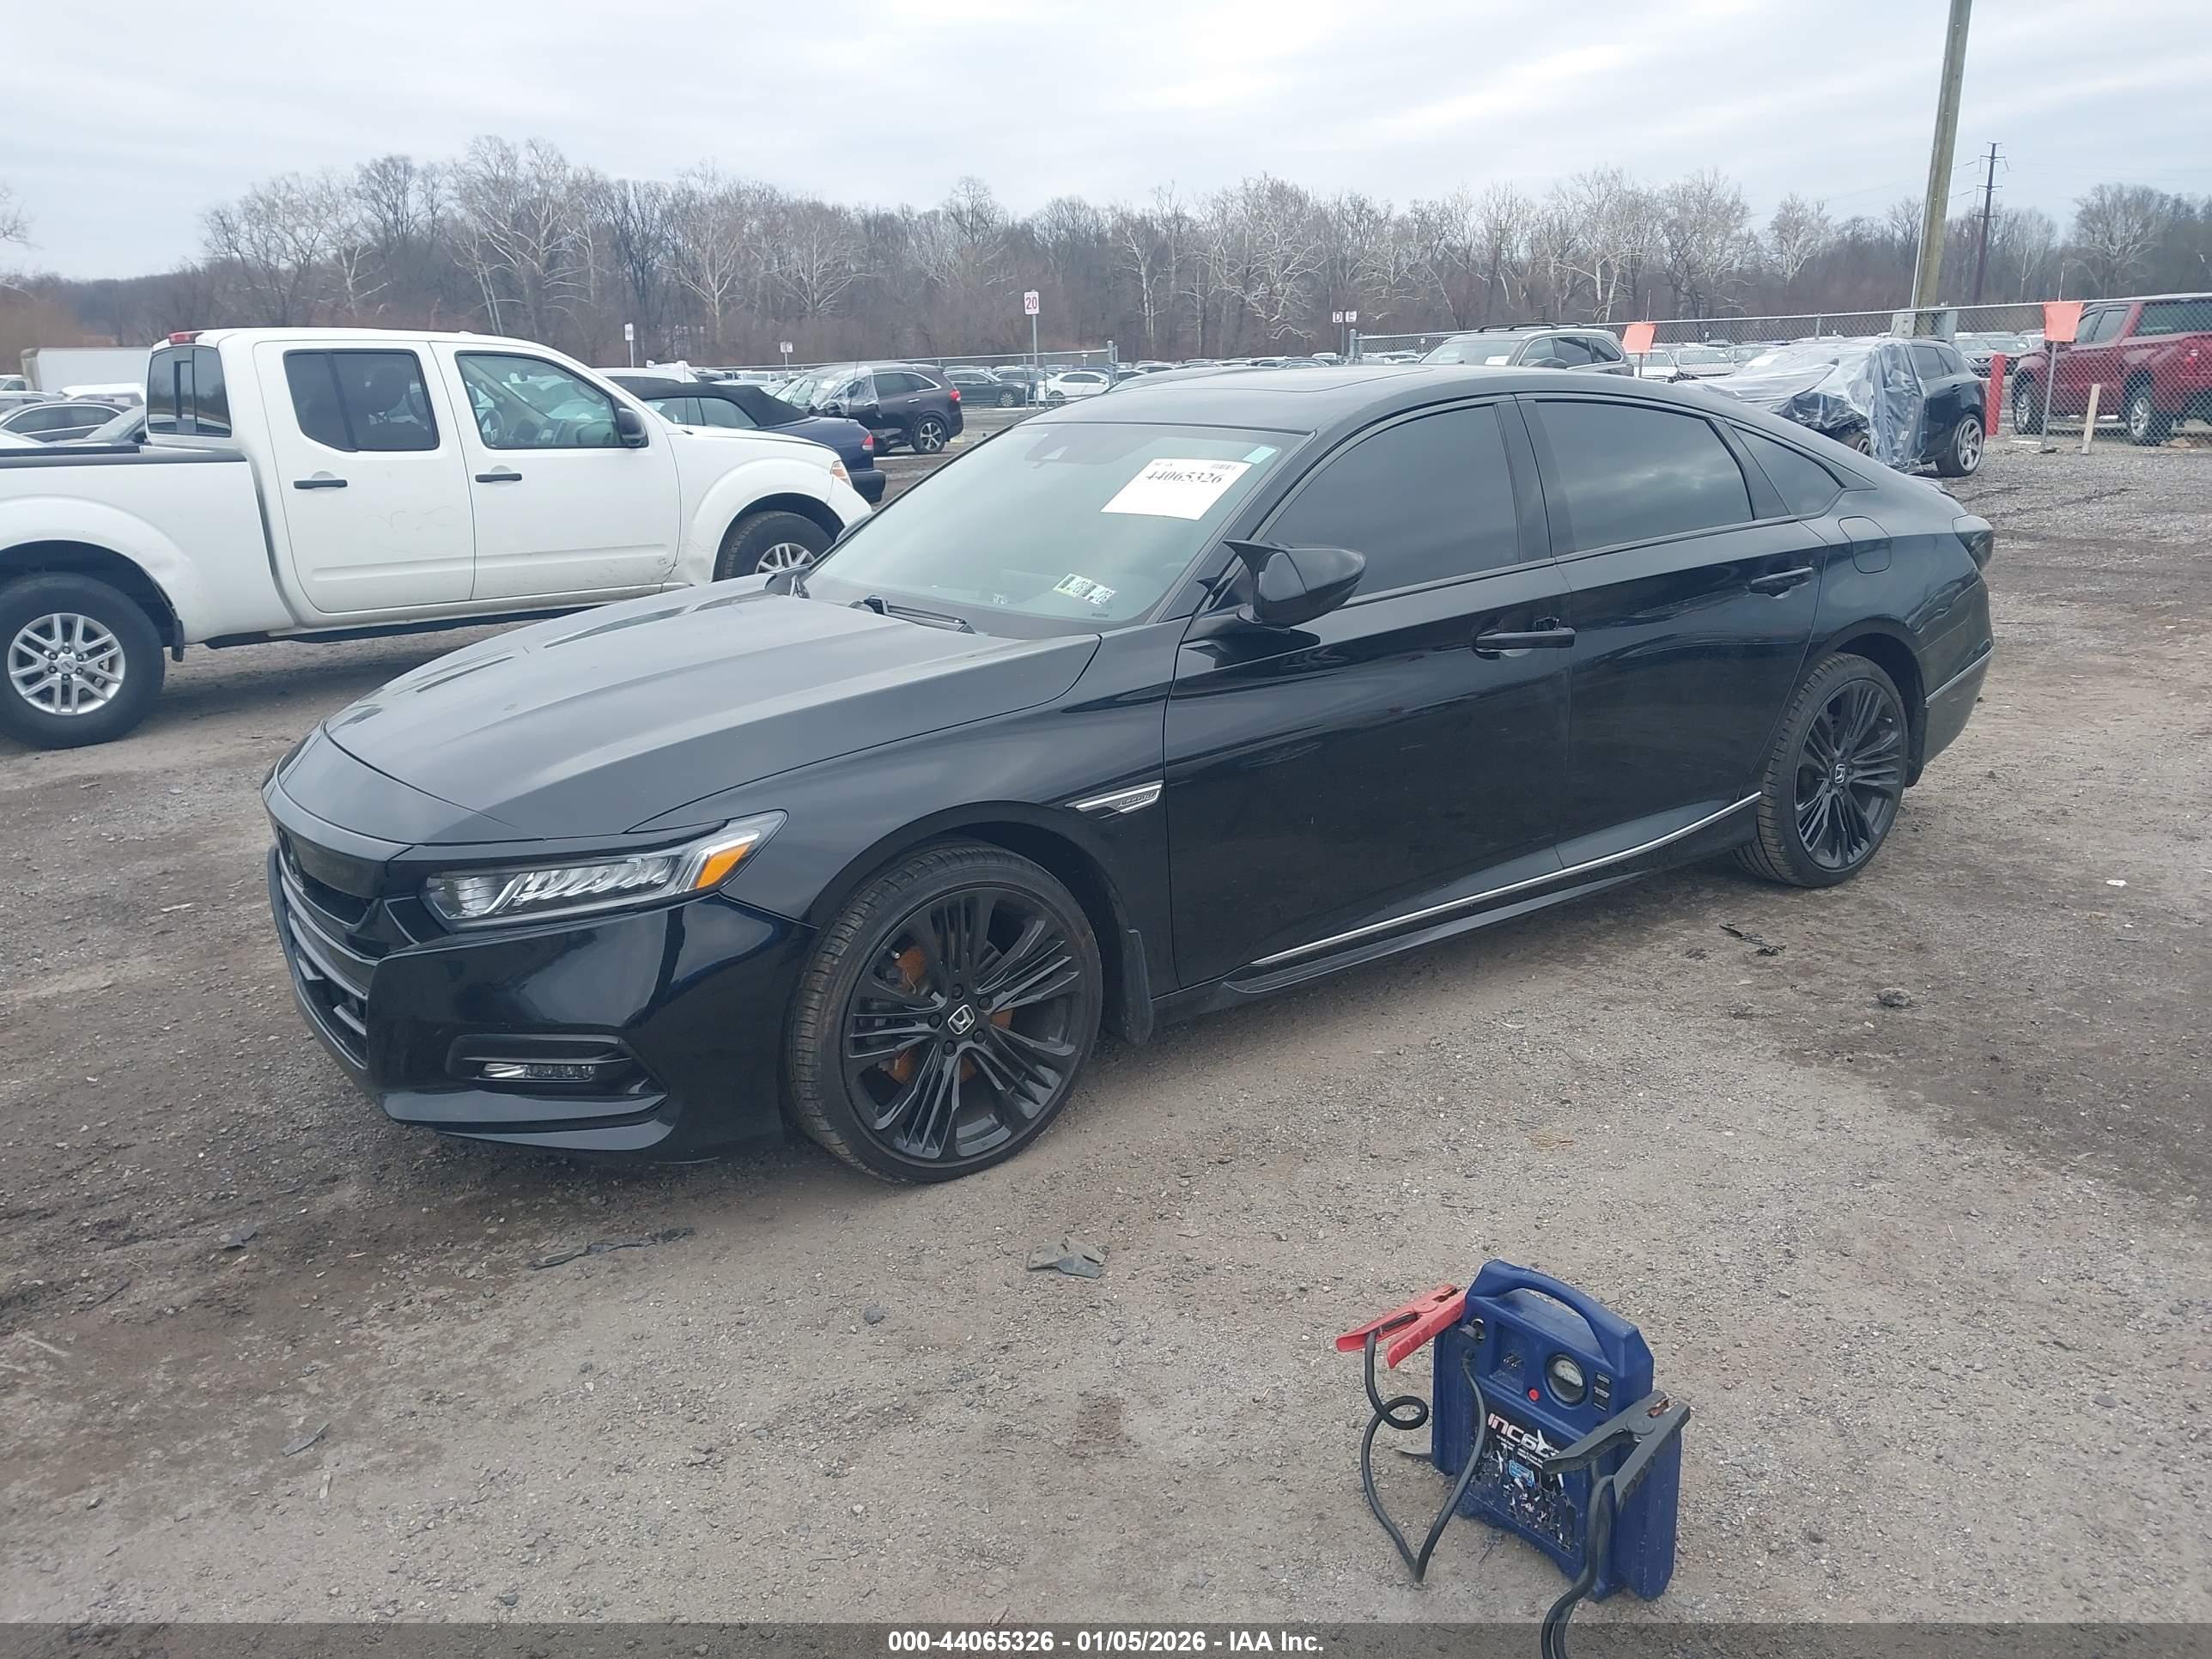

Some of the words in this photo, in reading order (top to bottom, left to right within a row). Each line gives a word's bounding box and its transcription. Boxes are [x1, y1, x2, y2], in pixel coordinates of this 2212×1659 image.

[1025, 296, 1037, 310] 20
[1334, 312, 1341, 322] D
[1146, 471, 1224, 483] 44065326
